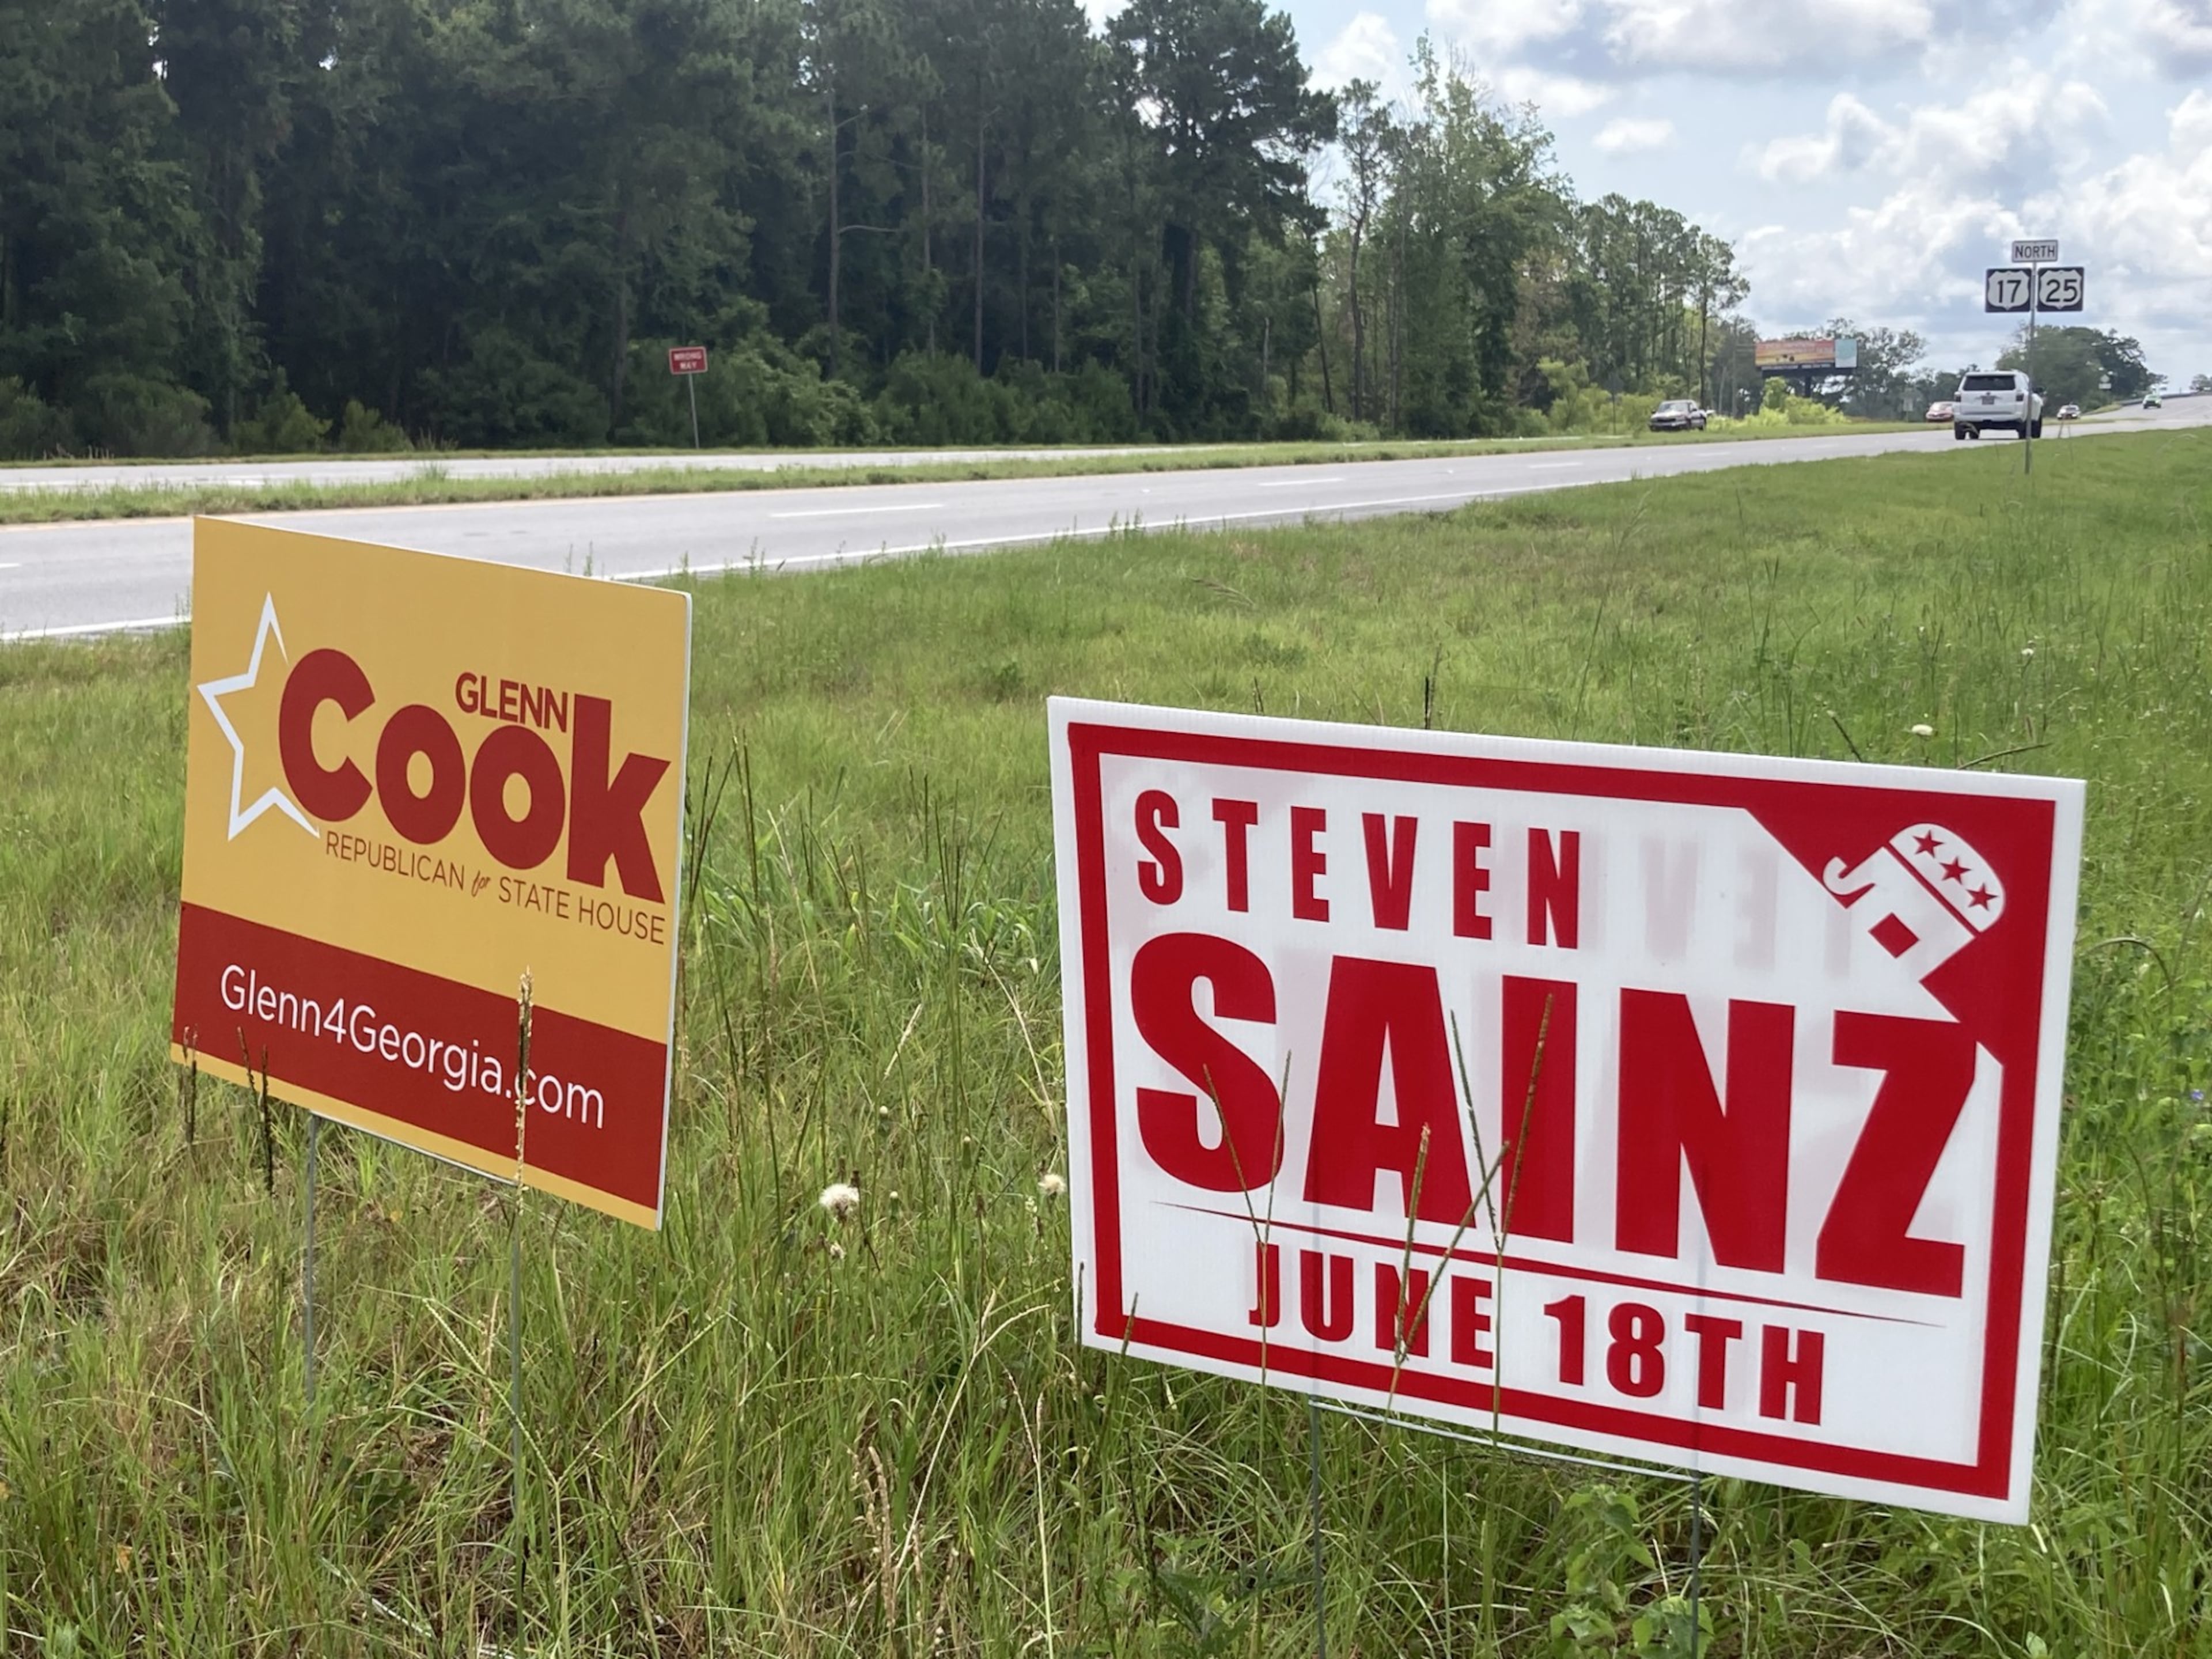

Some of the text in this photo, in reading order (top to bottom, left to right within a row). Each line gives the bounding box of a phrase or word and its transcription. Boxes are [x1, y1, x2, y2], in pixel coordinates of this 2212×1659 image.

[1997, 279, 2022, 304] 17
[2015, 245, 2055, 258] NORTH
[2046, 279, 2078, 303] 25
[455, 671, 568, 733] GLENN
[278, 648, 671, 904] Cook
[326, 831, 665, 945] REPUBLICAN for STATE HOUSE
[1135, 789, 1580, 949] STEVEN
[221, 964, 604, 1129] Glenn4Georgia.com
[1131, 932, 1976, 1298] SAINZ
[1249, 1241, 1824, 1425] JUNE 18TH
